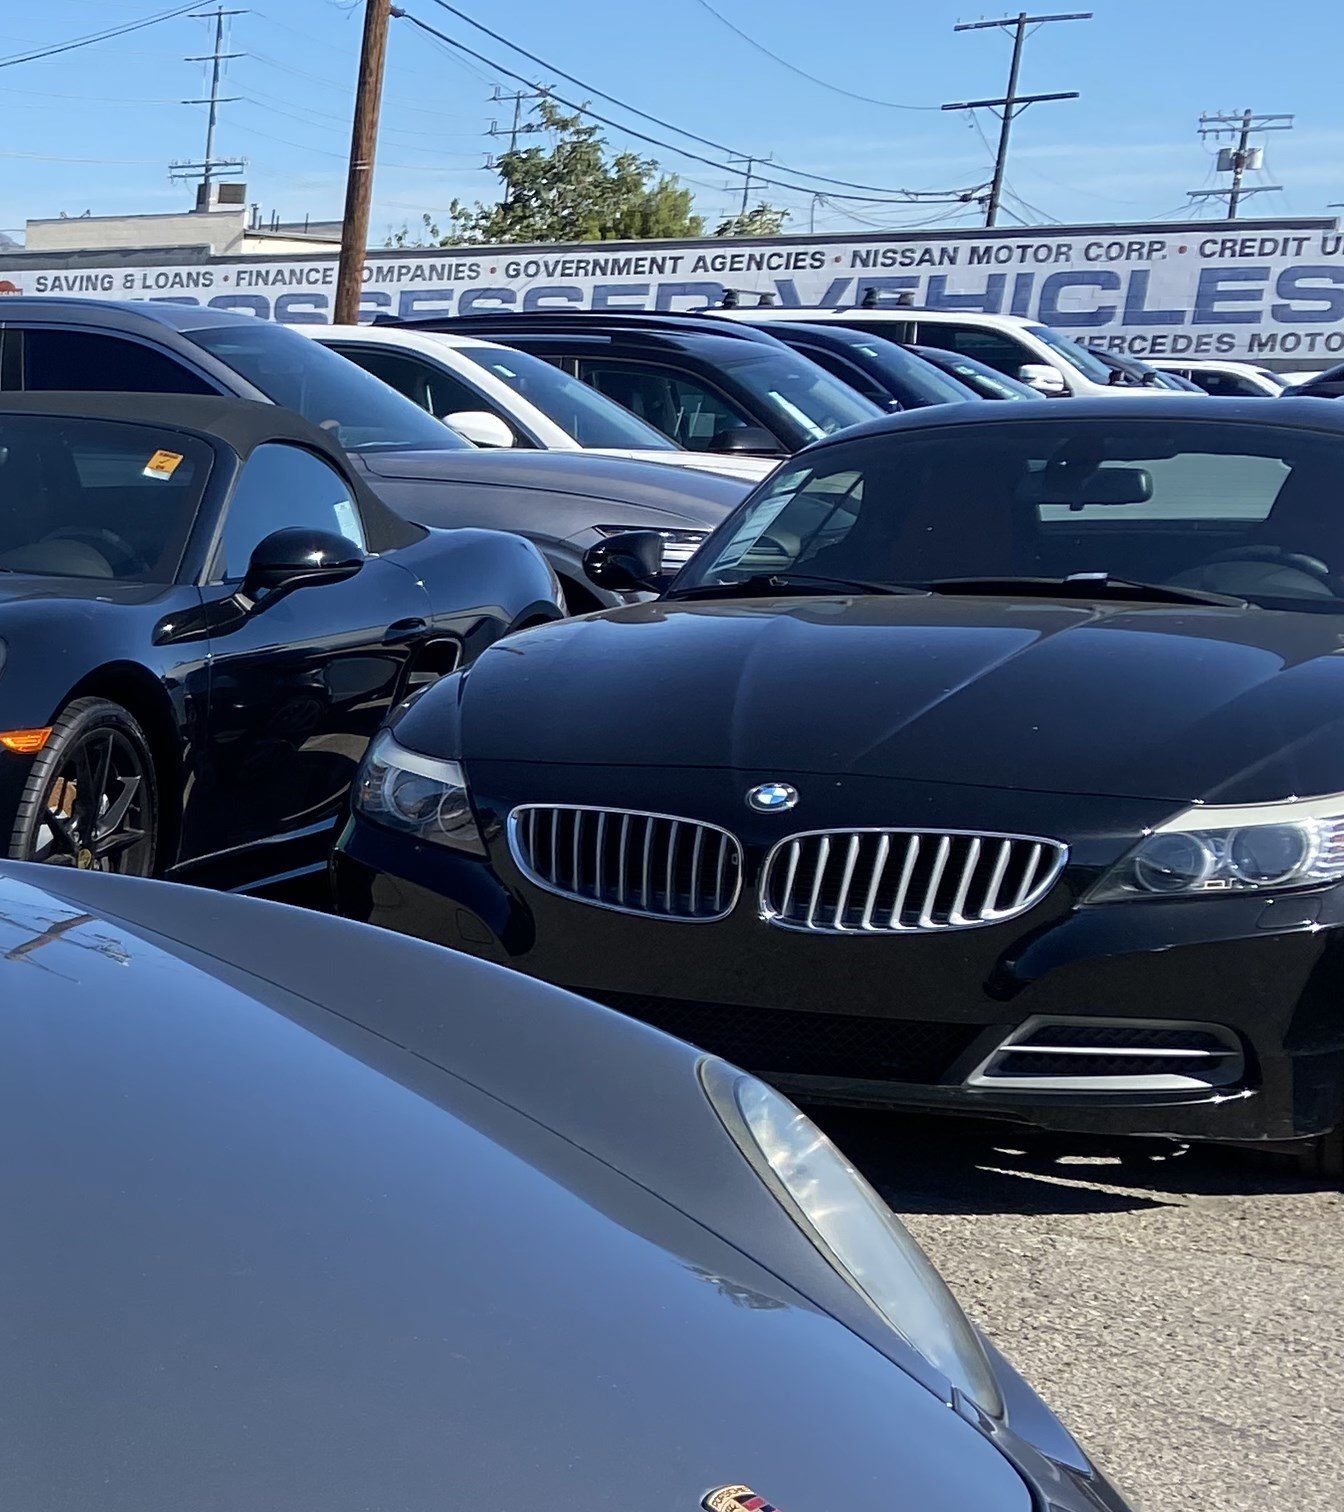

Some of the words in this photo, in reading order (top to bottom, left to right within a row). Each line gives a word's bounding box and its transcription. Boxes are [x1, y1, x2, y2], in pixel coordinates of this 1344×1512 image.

[35, 273, 114, 292] SAVING
[123, 273, 135, 289] &
[142, 271, 214, 290] LOANS
[236, 267, 335, 287] FINANCE
[361, 263, 481, 283] OMPANIES
[505, 256, 684, 279] GOVERNMENT
[691, 251, 826, 274] AGENCIES
[851, 245, 960, 268] NISSAN
[968, 243, 1073, 266] MOTOR
[1084, 240, 1167, 262] CORP.
[1199, 236, 1312, 258] CREDIT
[1321, 236, 1344, 256] U
